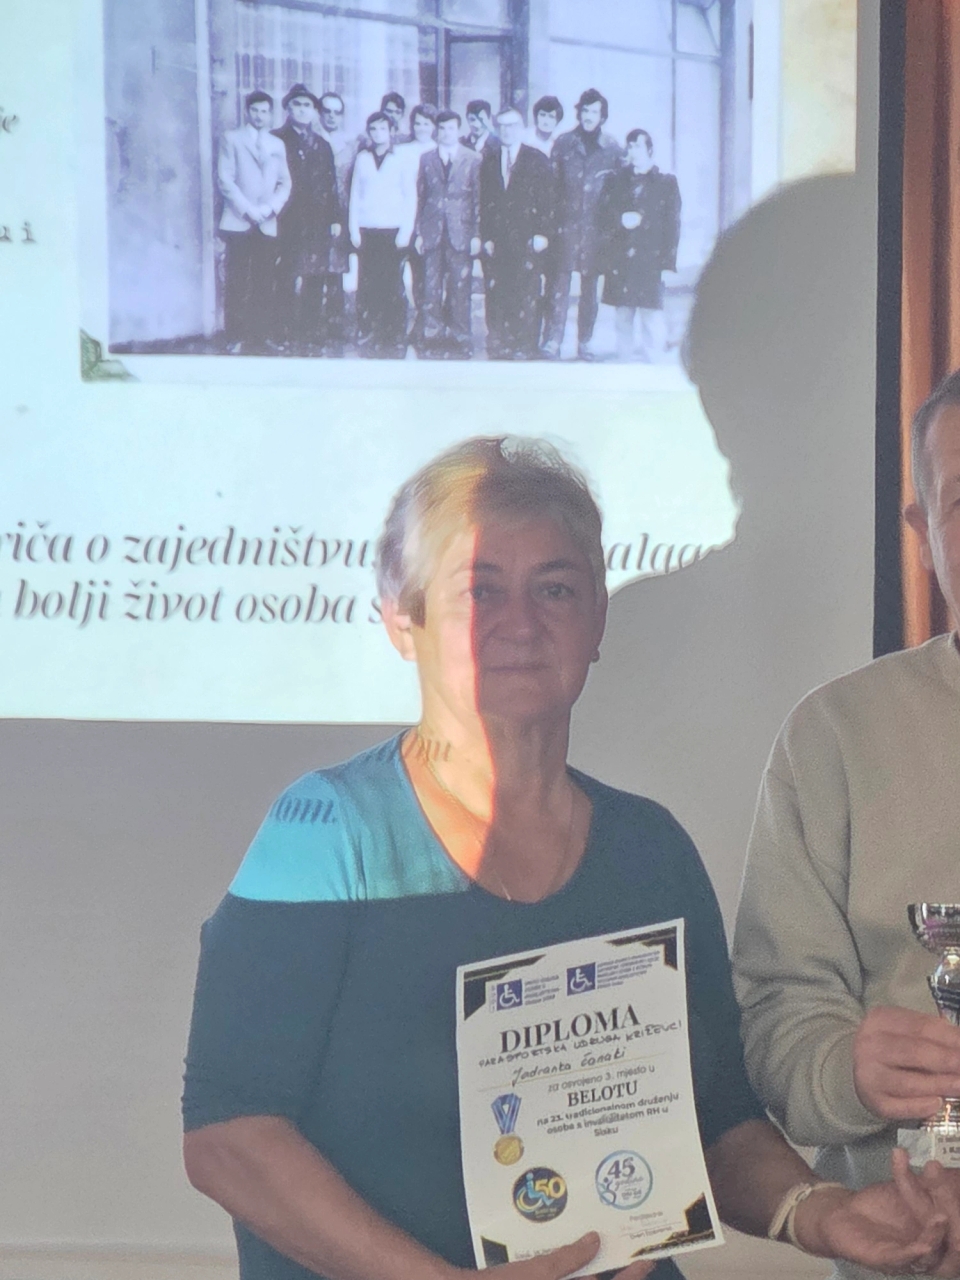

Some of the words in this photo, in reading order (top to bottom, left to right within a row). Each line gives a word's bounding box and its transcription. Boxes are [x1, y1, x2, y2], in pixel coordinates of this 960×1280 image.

[86, 535, 110, 563] o
[13, 578, 112, 629] bolji
[123, 579, 224, 622] život
[234, 583, 356, 624] osoba
[499, 1004, 641, 1053] DIPLOMA
[561, 1075, 603, 1090] osvojeno
[616, 1065, 647, 1080] mjesto
[567, 1080, 638, 1107] BELOTU
[646, 1106, 660, 1117] RH
[607, 1156, 636, 1179] 45
[535, 1176, 566, 1199] 50
